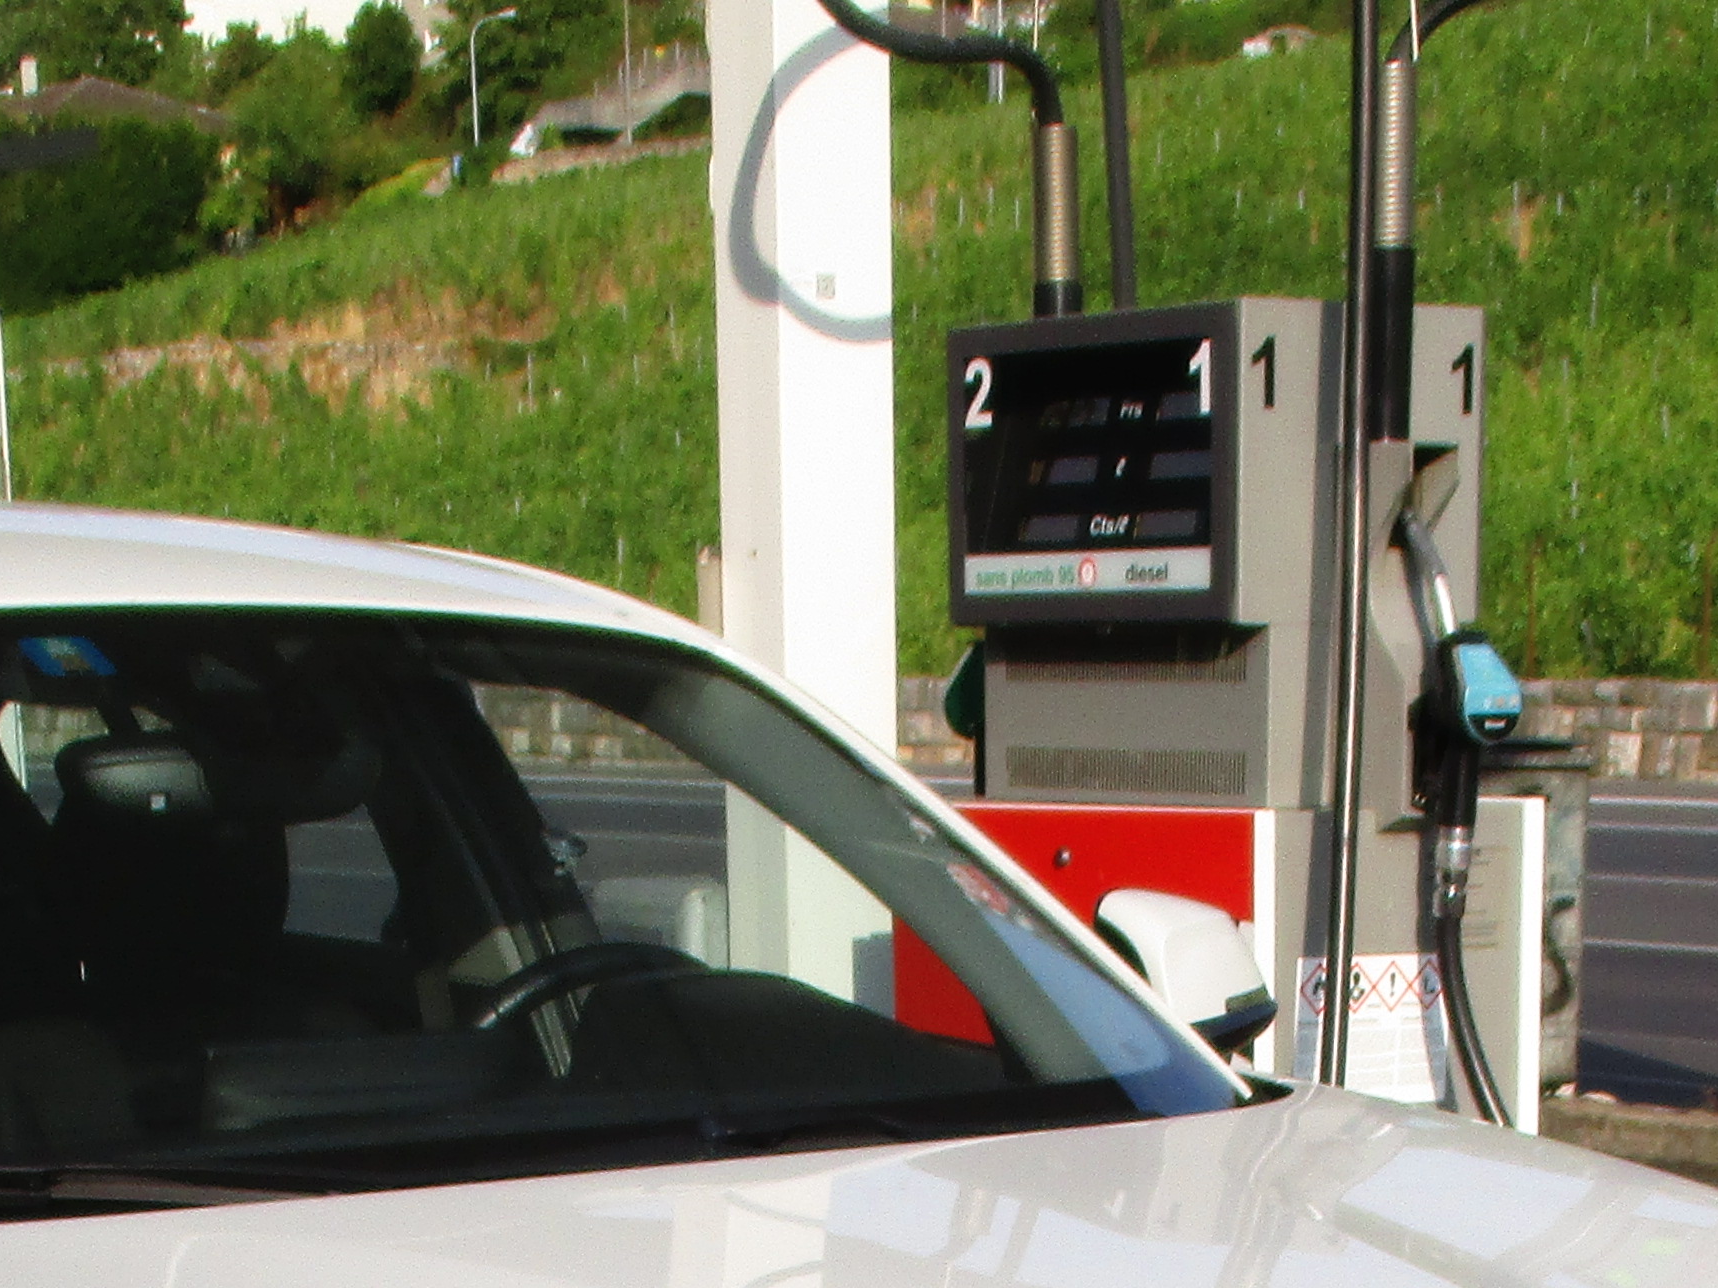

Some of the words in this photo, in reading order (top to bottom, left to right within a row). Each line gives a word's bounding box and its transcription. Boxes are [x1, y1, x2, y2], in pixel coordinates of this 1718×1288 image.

[964, 356, 994, 429] 2
[1189, 338, 1212, 416] 1
[1251, 335, 1276, 409] 1
[1451, 343, 1476, 415] 1
[1124, 561, 1169, 582] diesel
